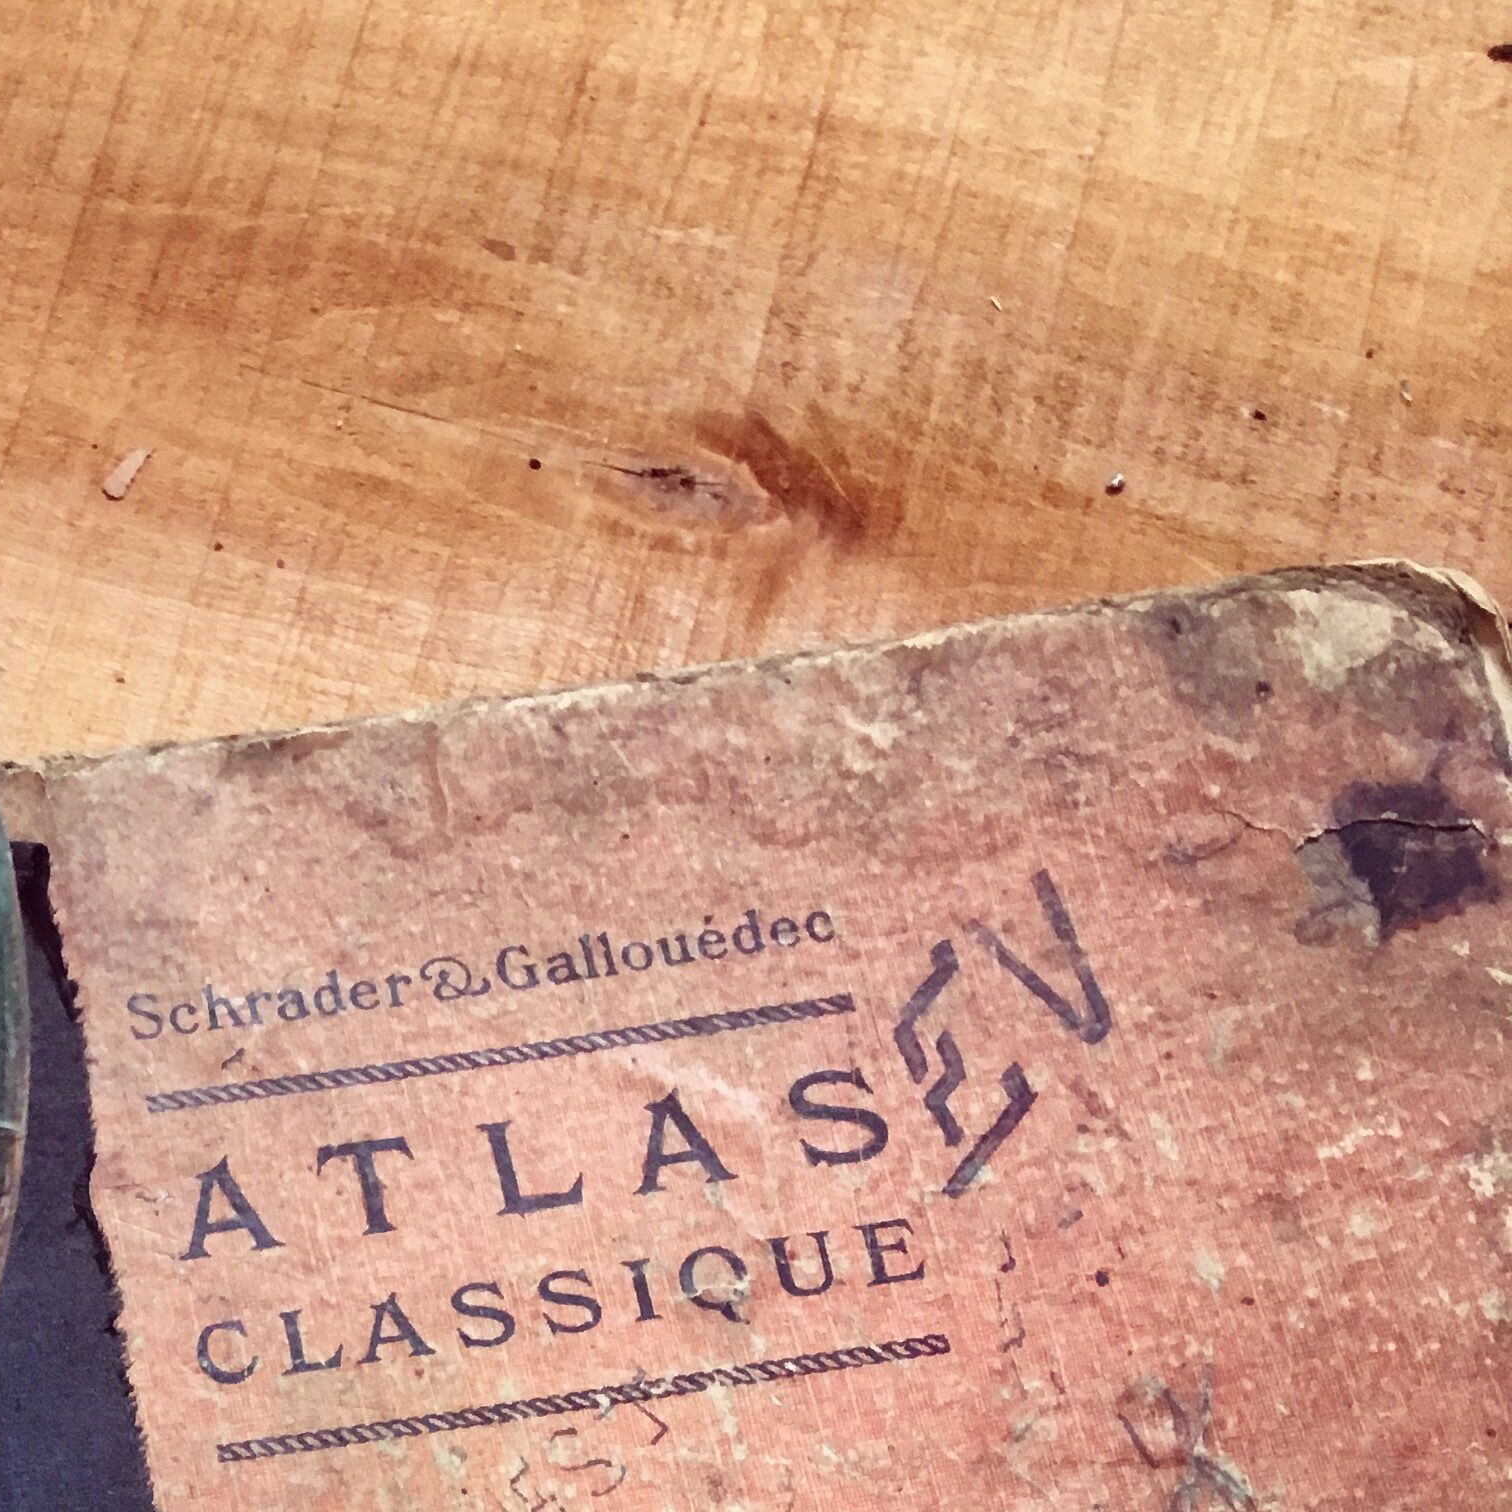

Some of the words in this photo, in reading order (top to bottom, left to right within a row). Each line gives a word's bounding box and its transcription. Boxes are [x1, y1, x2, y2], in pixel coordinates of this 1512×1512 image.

[126, 968, 412, 1041] Schrader
[494, 908, 837, 992] Gallouédec
[179, 1068, 890, 1260] ATLAS
[196, 1217, 927, 1386] CLASSIQUE
